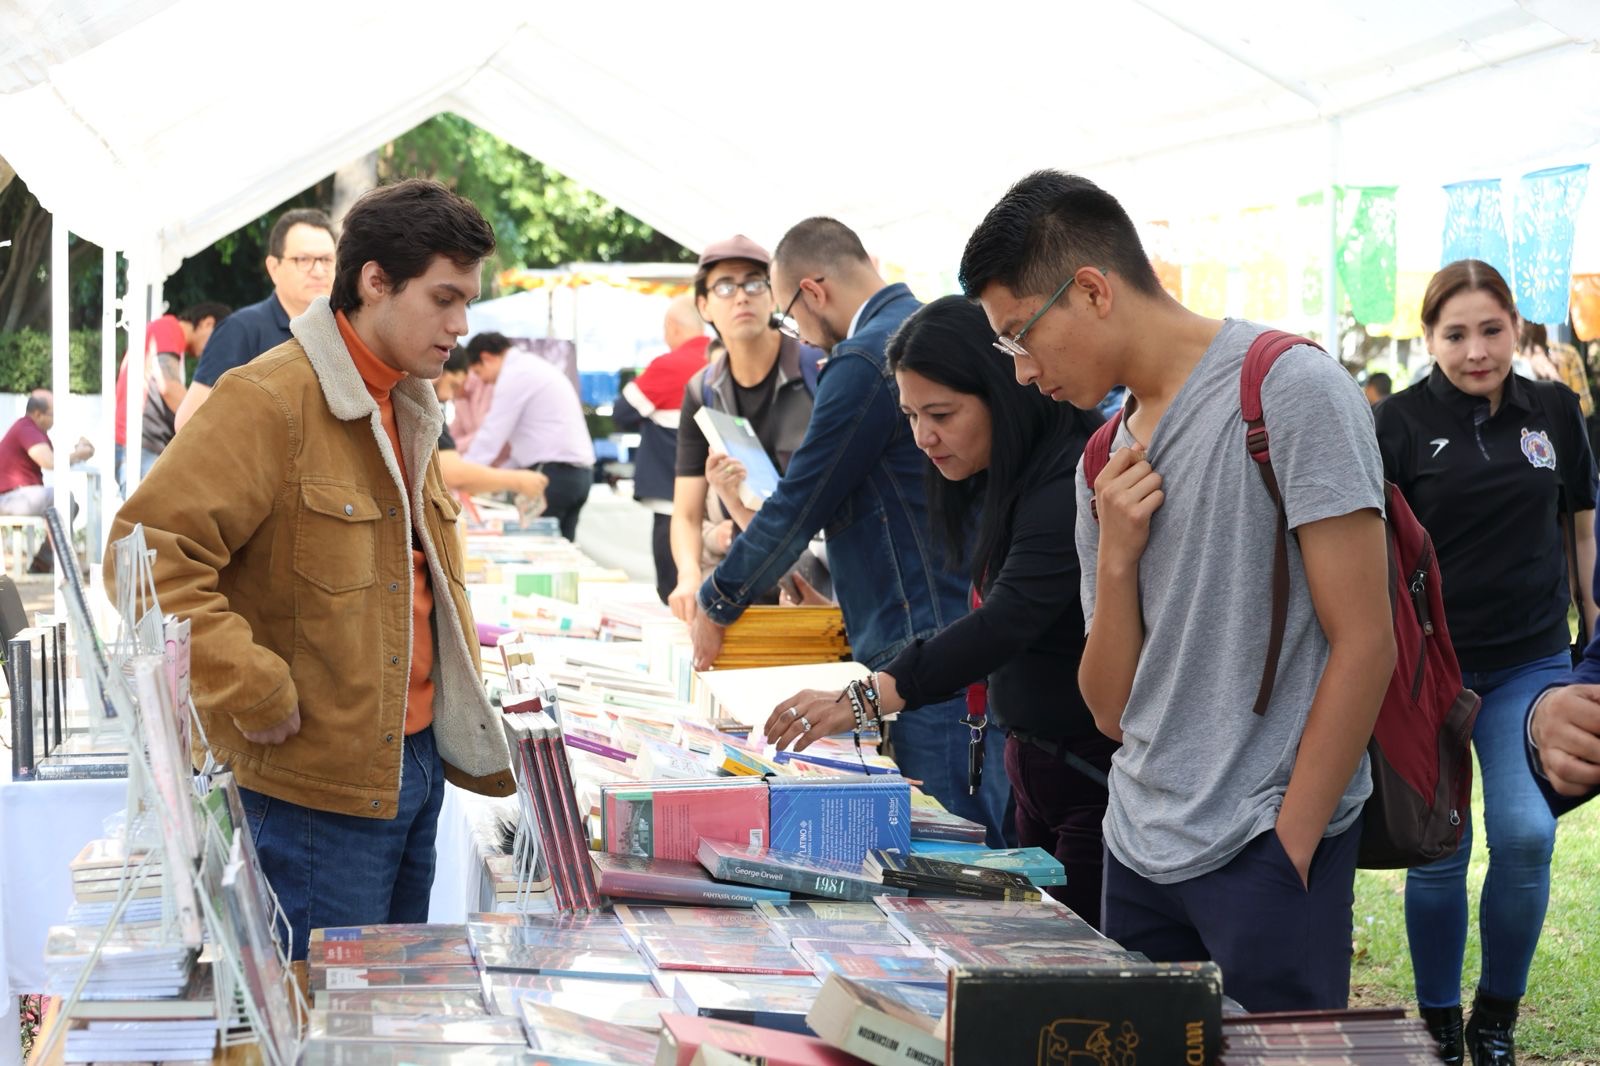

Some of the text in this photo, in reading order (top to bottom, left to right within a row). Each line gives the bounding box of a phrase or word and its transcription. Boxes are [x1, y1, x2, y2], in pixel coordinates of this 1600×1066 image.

[799, 829, 807, 856] LATINO
[734, 866, 784, 882] George Orwell
[858, 1026, 899, 1051] HUTCHINSON
